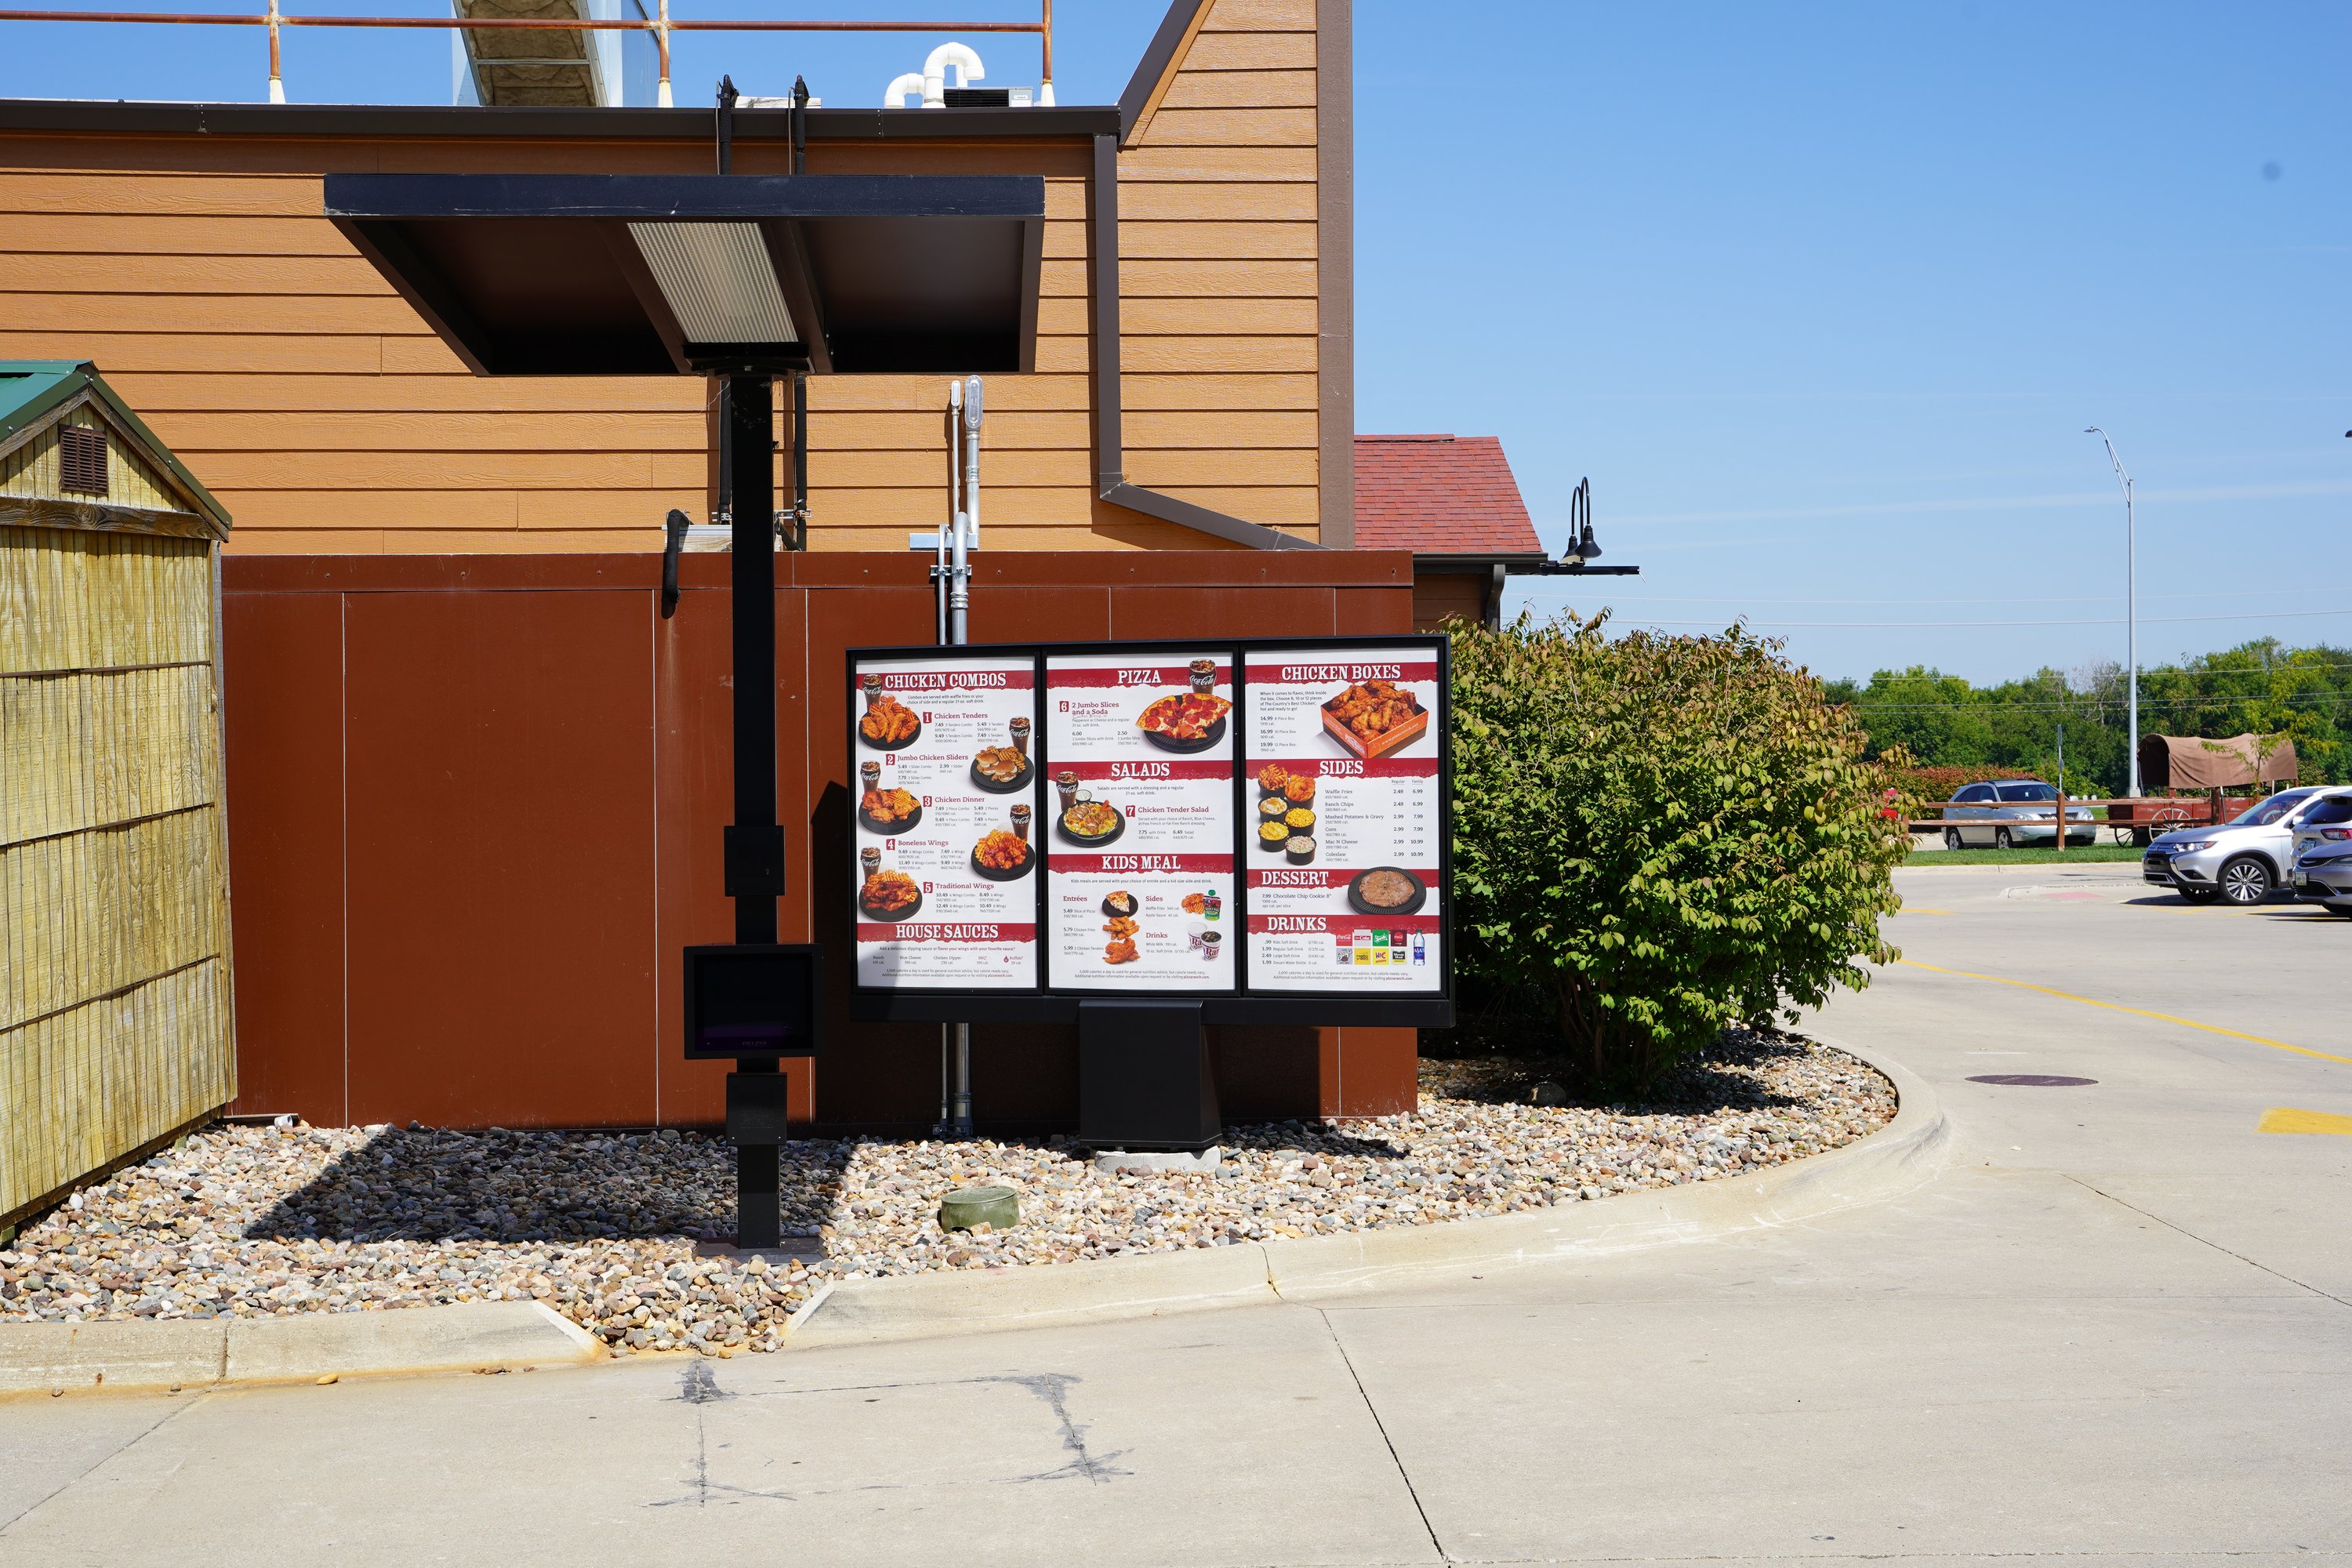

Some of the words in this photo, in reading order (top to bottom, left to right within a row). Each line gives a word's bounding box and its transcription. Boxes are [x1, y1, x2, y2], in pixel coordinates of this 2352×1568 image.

[1117, 670, 1161, 684] PIZZA
[1282, 666, 1348, 681] CHICKEN
[1352, 665, 1400, 680] BOXES
[885, 673, 946, 688] CHICKEN
[949, 673, 1007, 688] COMBOS
[1062, 702, 1067, 711] 6
[925, 713, 930, 722] 1
[888, 755, 893, 764] 2
[1111, 763, 1170, 777] SALADS
[1319, 760, 1364, 775] SIDES
[1127, 807, 1134, 816] 7
[887, 840, 894, 849] 4
[1102, 855, 1138, 869] KIDS
[1141, 855, 1181, 869] MEAL
[1261, 871, 1329, 885] DESSERT
[925, 884, 930, 892] 5
[1268, 916, 1327, 931] DRINKS
[895, 925, 941, 938] HOUSE
[944, 925, 998, 938] SAUCES
